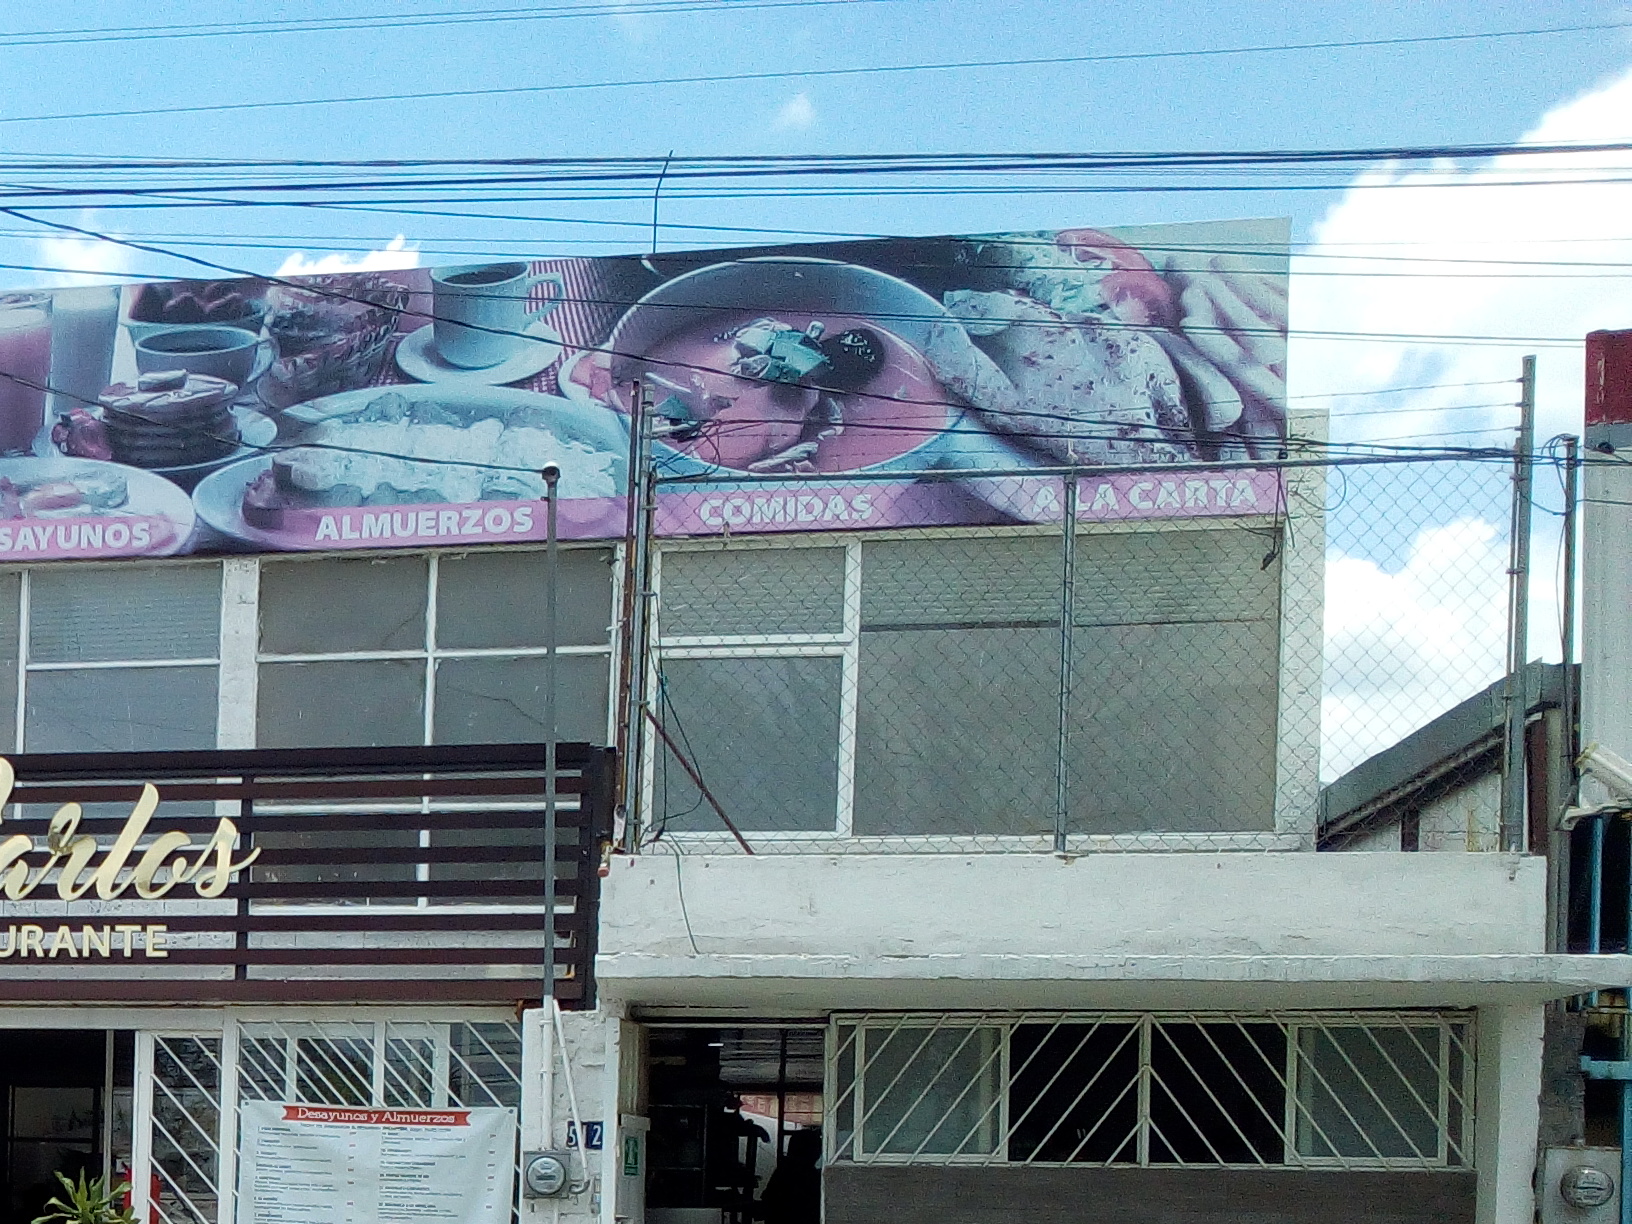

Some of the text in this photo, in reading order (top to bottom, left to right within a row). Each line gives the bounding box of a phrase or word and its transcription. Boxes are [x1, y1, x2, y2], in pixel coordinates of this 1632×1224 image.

[700, 494, 873, 525] COMIDAS
[1032, 479, 1258, 513] A LA CARTA
[315, 506, 534, 541] ALMUERZOS
[297, 1107, 455, 1123] Desayunos y Almuerzos
